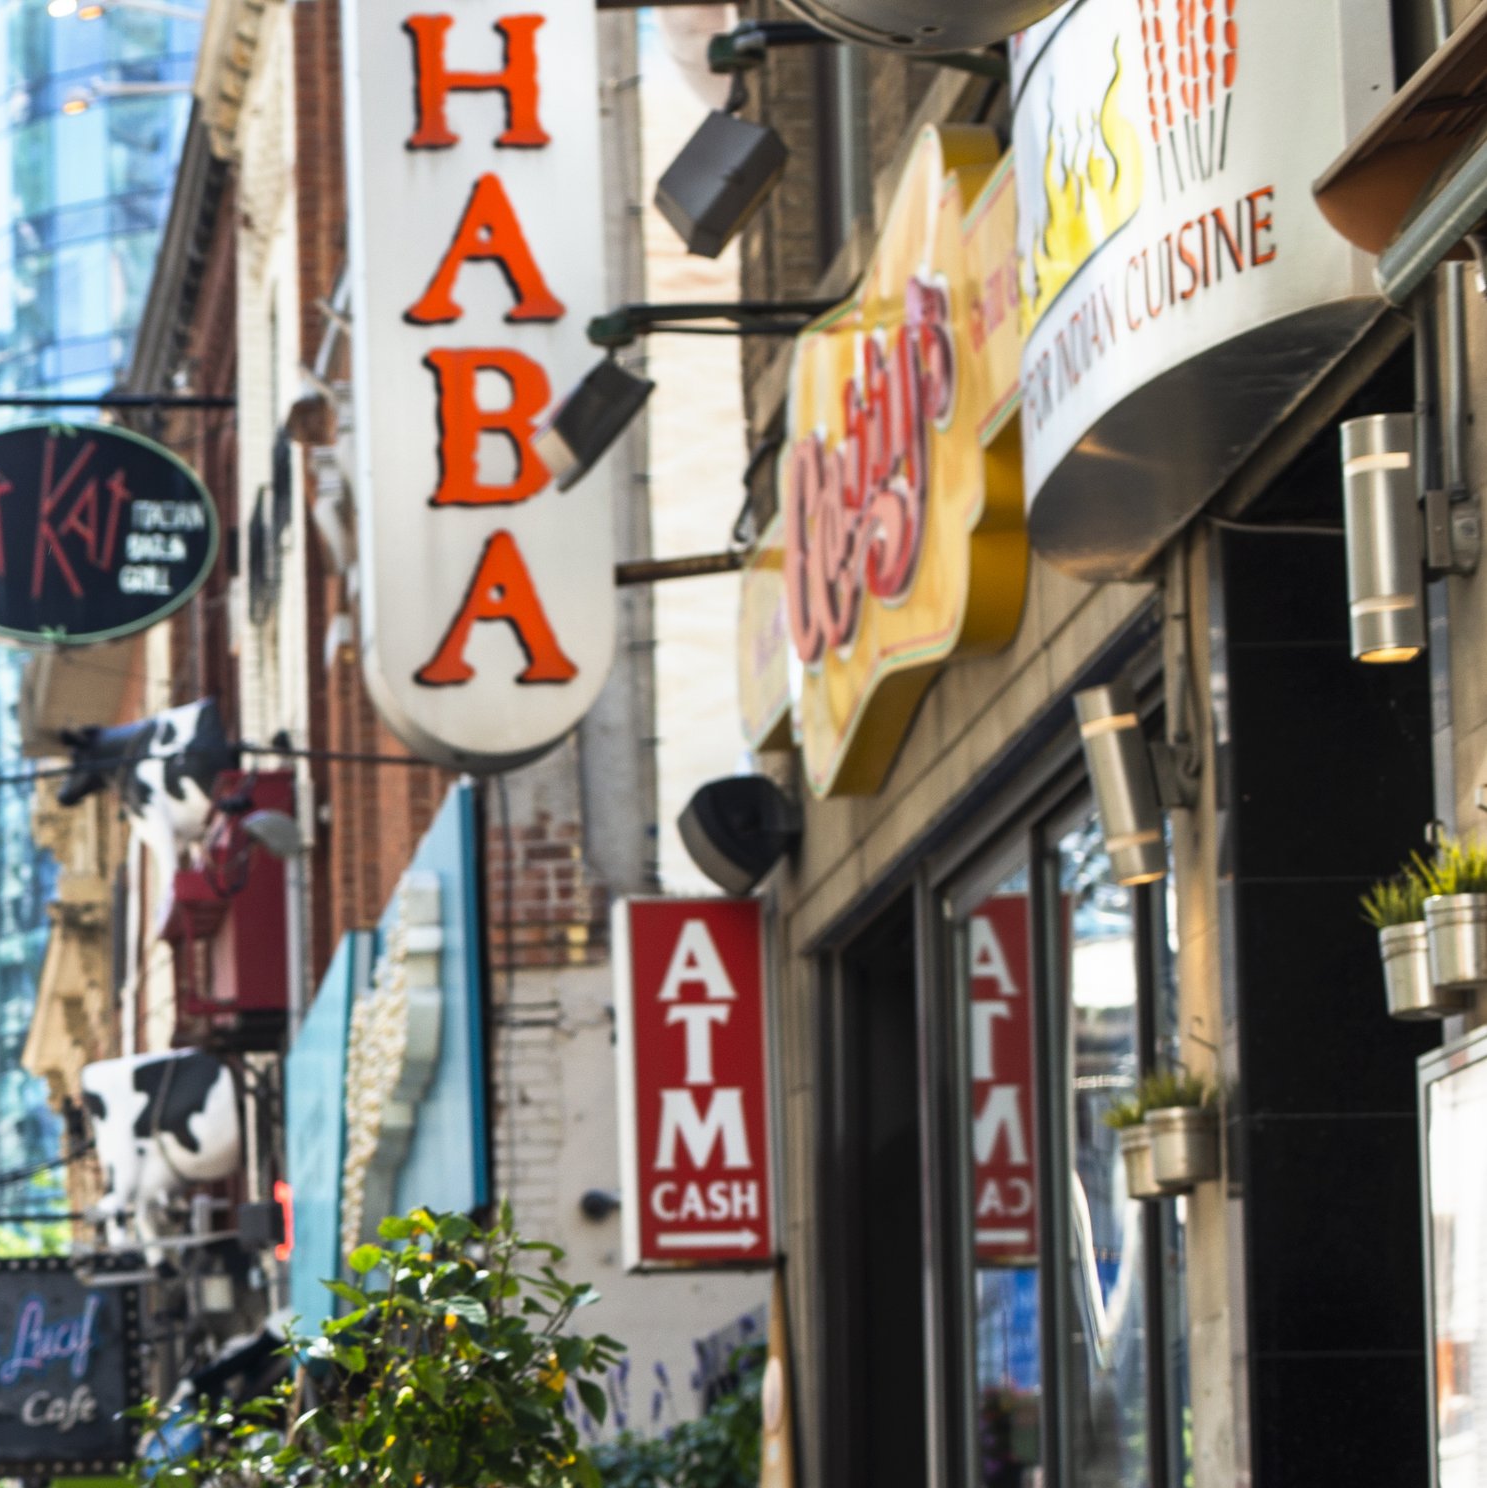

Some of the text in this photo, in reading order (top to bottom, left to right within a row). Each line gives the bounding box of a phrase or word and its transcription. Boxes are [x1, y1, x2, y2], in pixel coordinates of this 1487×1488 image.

[1125, 185, 1277, 331] CUISINE
[654, 919, 752, 1171] ATM
[651, 1181, 759, 1221] CASH
[0, 1295, 102, 1382] Lucy
